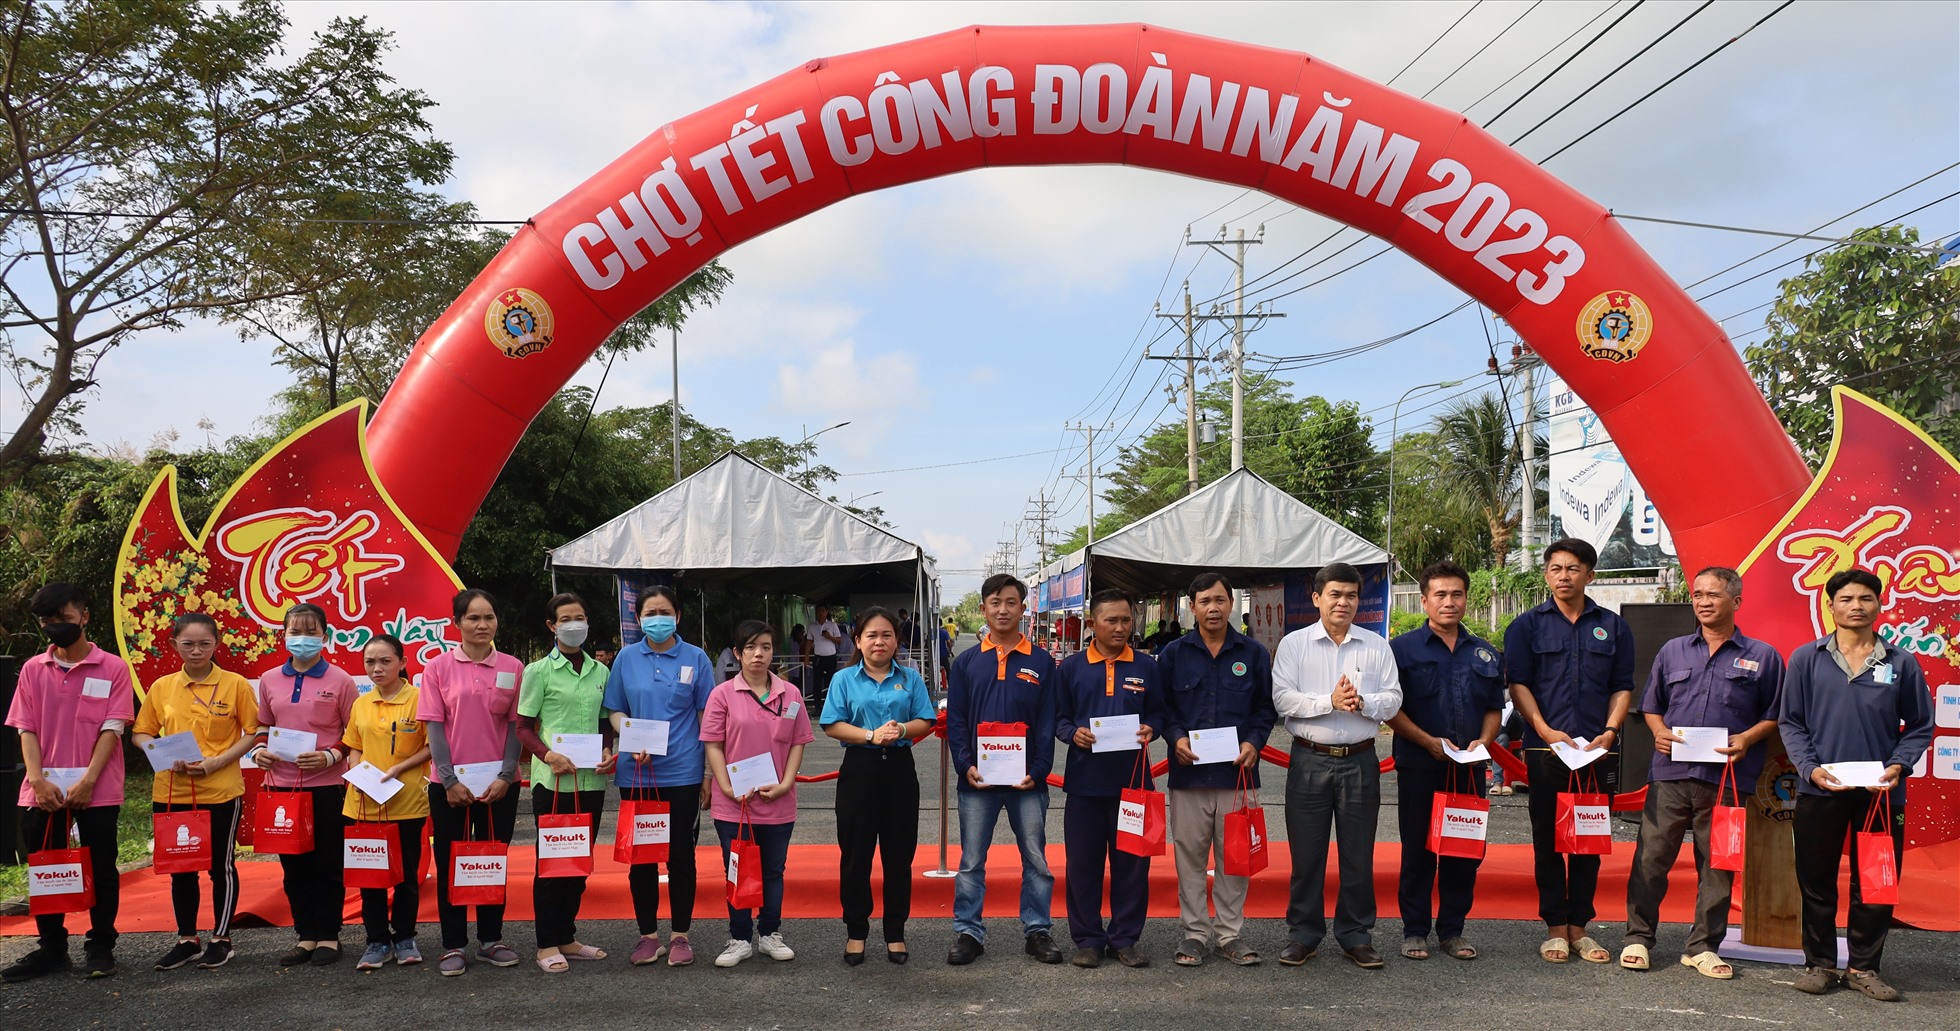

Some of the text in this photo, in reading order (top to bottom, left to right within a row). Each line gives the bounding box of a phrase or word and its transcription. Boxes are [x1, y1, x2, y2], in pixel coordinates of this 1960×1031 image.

[562, 156, 703, 290] CHỢ
[689, 104, 815, 216] TẾT
[819, 67, 1016, 167] CÔNG
[1400, 157, 1586, 305] 2023
[1555, 391, 1573, 408] KGB
[1568, 459, 1602, 483] Indewa
[1558, 482, 1590, 523] Indewa
[1594, 479, 1624, 526] Indewa
[219, 510, 402, 628] Tết
[981, 743, 1023, 751] Yakult
[1446, 814, 1483, 825] Yakult
[1577, 812, 1607, 820] Yakult
[636, 820, 667, 829] Yakult
[543, 833, 586, 843] Yakult
[349, 845, 386, 854] Yakult
[460, 862, 502, 871] Yakult
[34, 870, 79, 880] Yakult
